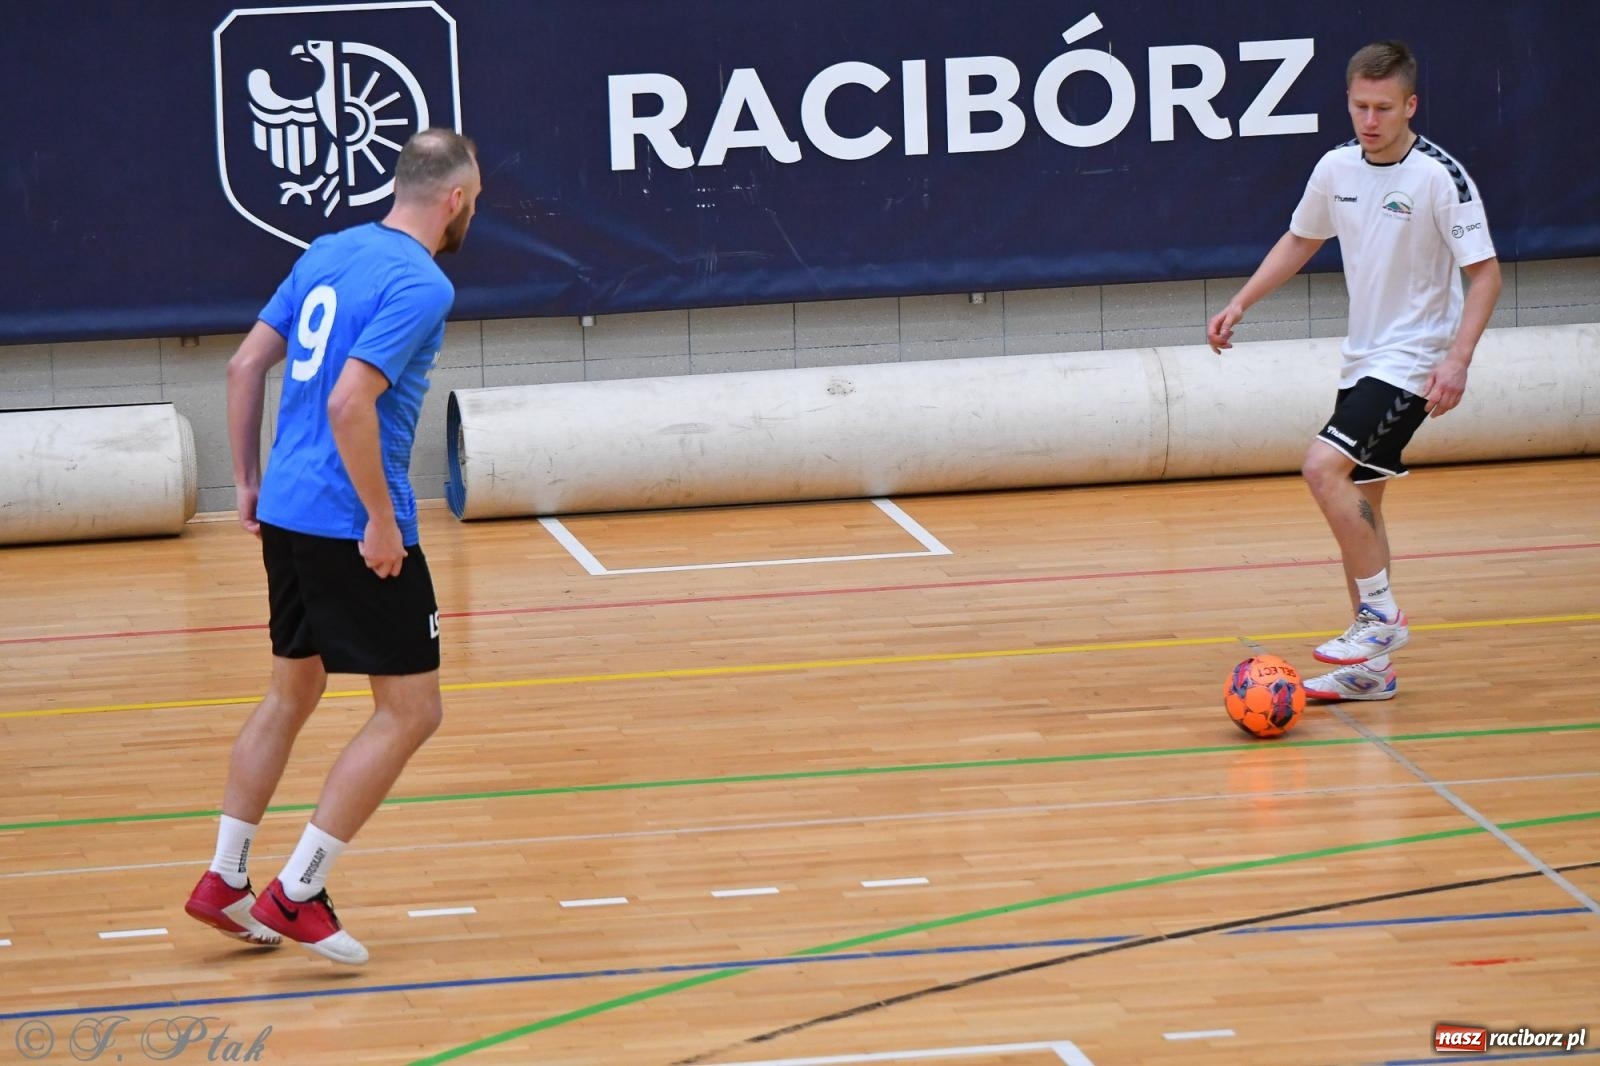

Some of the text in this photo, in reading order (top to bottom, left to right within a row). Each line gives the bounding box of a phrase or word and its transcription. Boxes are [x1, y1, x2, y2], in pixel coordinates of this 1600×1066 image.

[608, 12, 1319, 171] RACIBÓRZ
[291, 284, 338, 382] 9
[1258, 666, 1297, 678] SELECT
